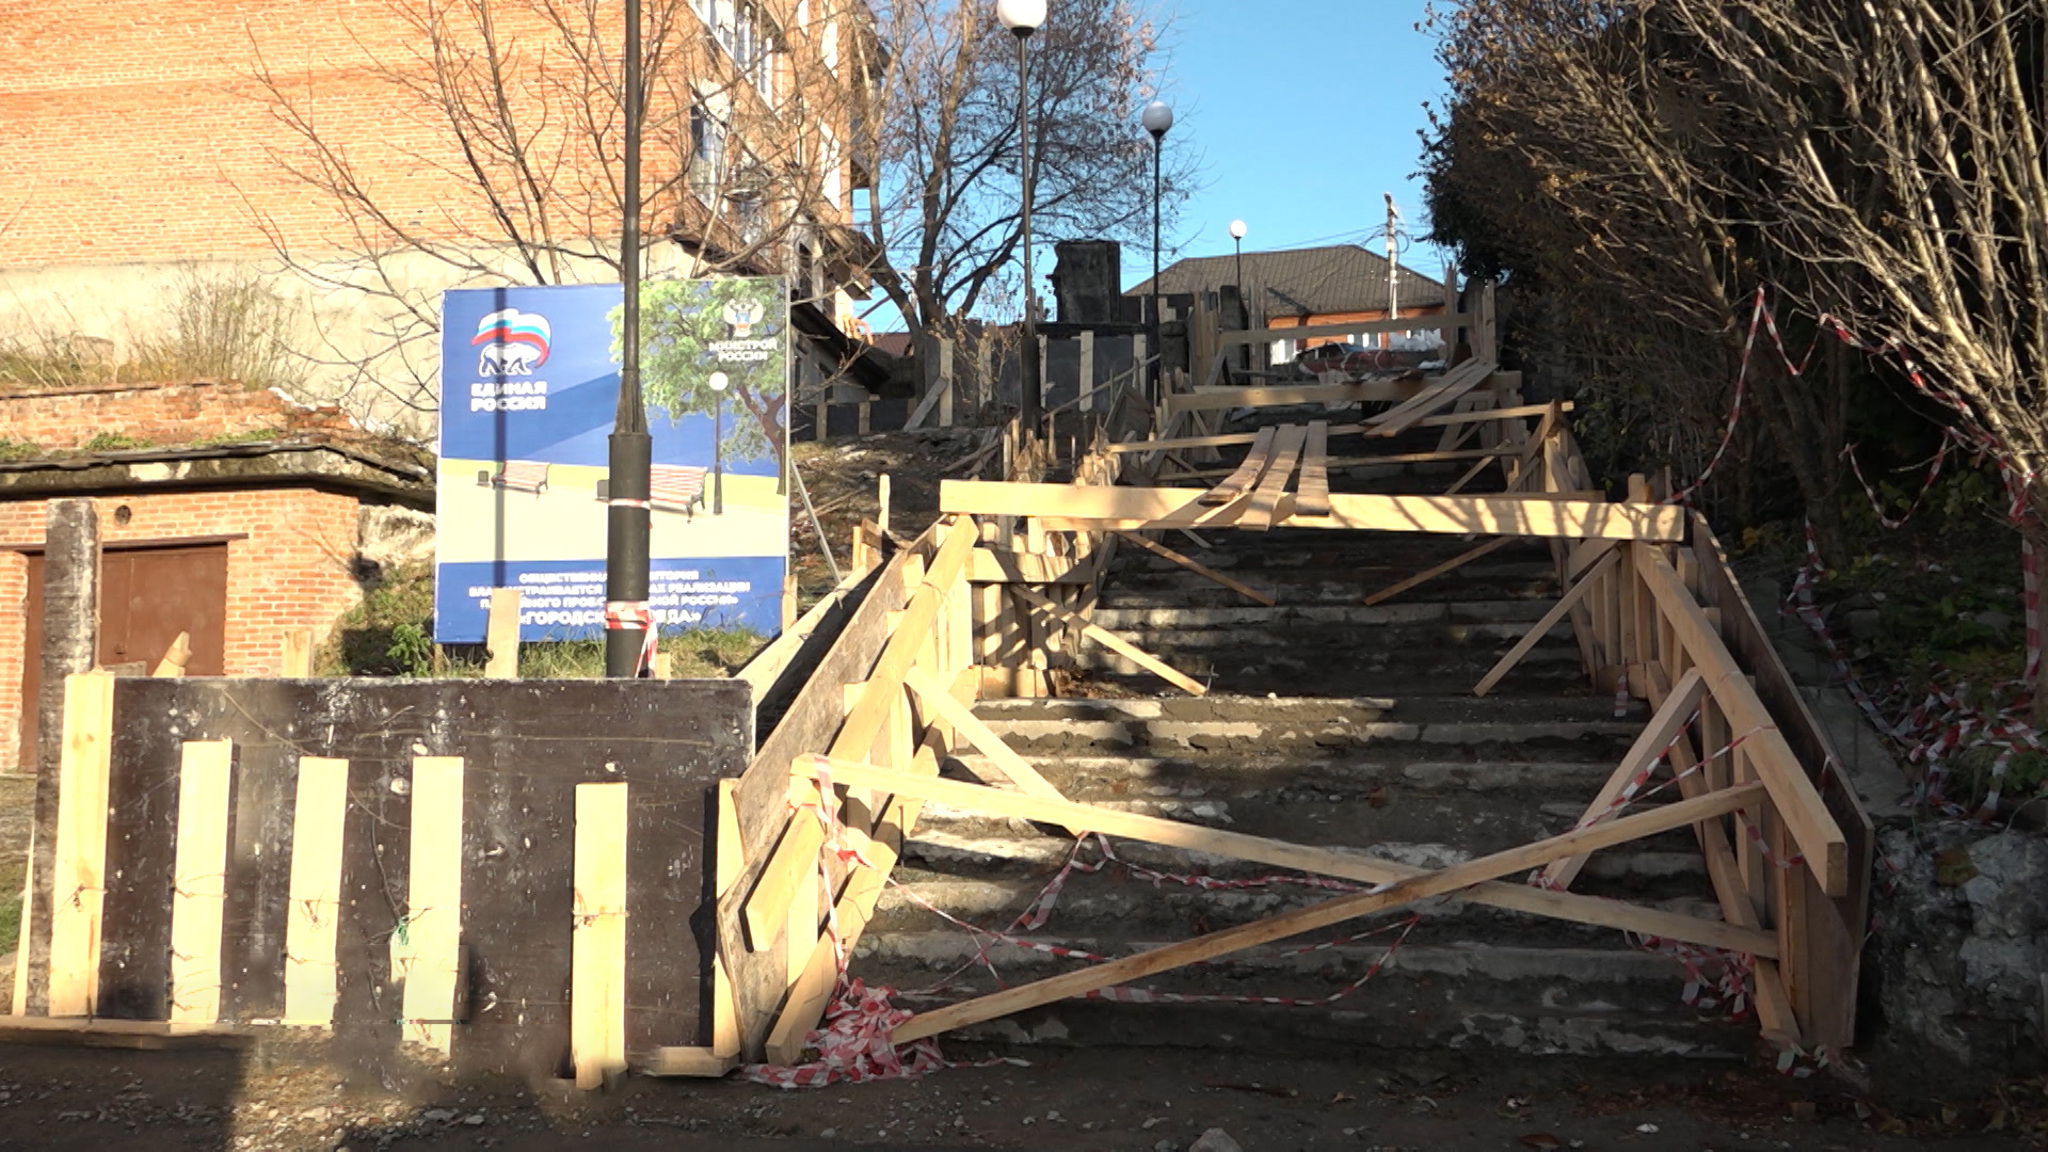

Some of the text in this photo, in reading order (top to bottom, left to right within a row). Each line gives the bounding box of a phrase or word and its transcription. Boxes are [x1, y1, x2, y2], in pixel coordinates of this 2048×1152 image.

[718, 351, 768, 362] РОССИИ
[471, 381, 547, 396] ЕДИНАЯ
[471, 396, 546, 412] РОССИЯ
[668, 581, 750, 593] РЕАЛИЗАЦИИ
